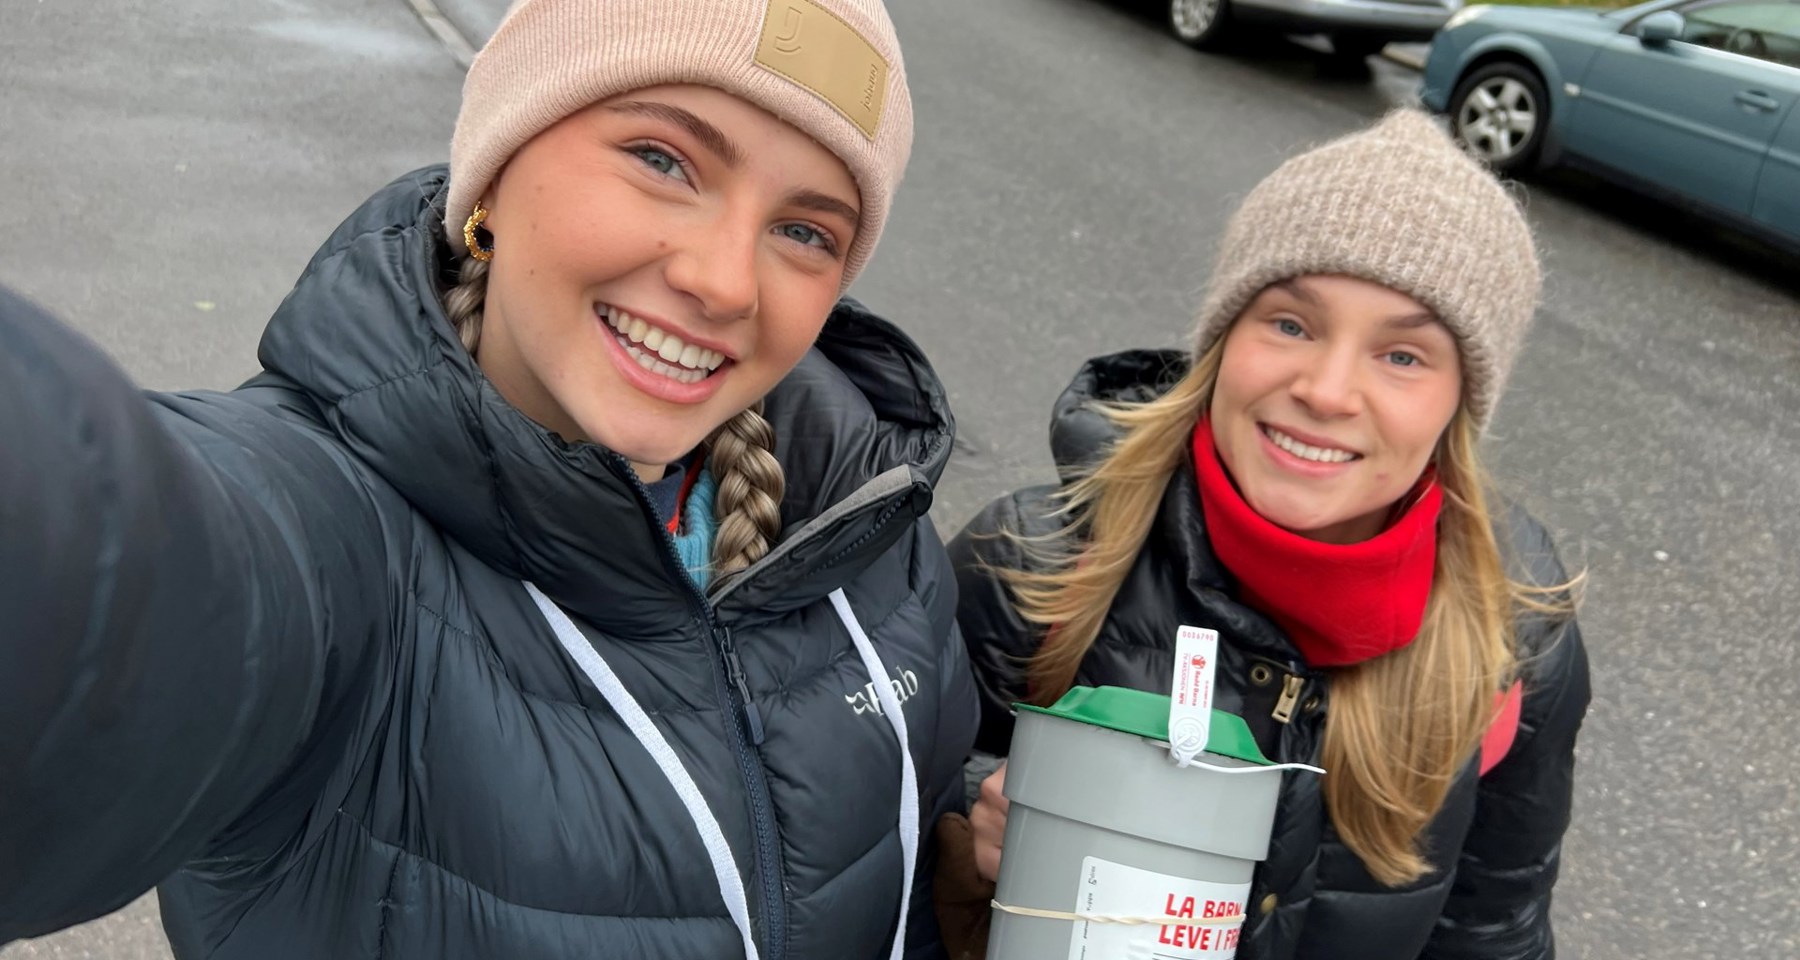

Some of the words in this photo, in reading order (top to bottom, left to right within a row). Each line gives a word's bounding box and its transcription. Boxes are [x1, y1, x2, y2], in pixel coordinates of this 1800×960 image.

[1165, 893, 1195, 918] LA
[1203, 900, 1242, 918] BARN
[1158, 924, 1212, 950] LEVE
